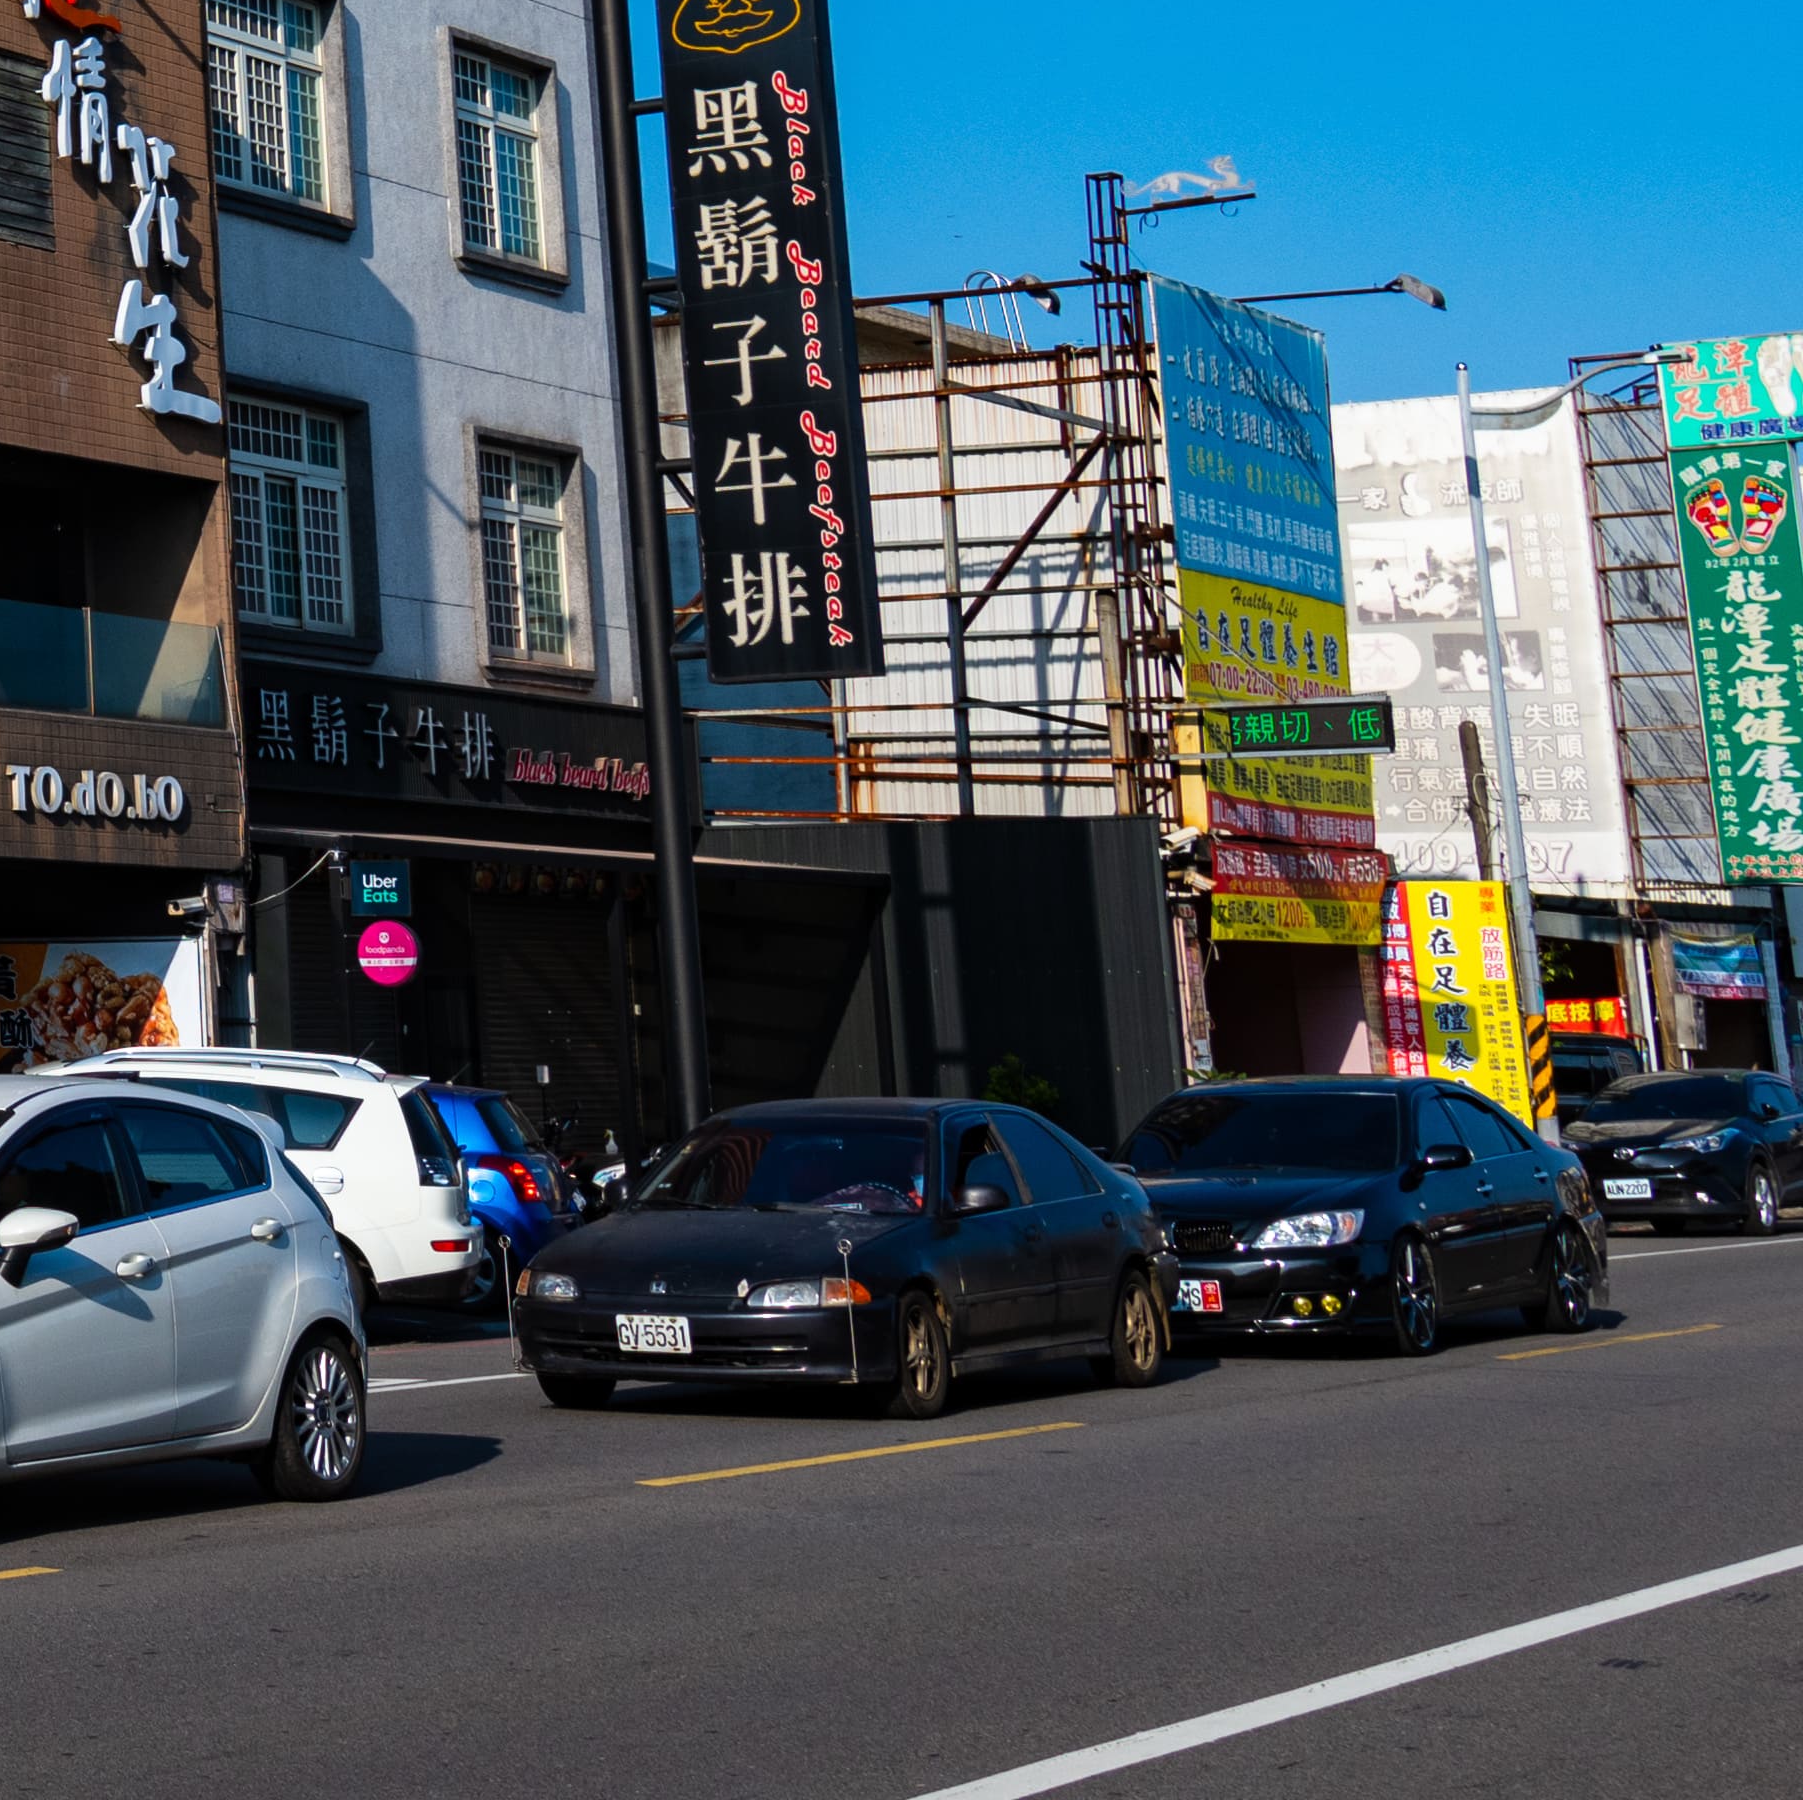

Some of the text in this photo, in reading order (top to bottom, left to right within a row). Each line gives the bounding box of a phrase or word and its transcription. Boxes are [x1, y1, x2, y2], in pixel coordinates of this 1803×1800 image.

[683, 78, 813, 648] 黑鬍子牛排
[771, 66, 851, 652] Black Beard Beefsteak
[1195, 608, 1340, 679] 自在足體養生館
[1231, 586, 1299, 623] Healthy Life
[256, 687, 495, 782] 黑鬍子牛排
[362, 873, 398, 889] Uber
[362, 889, 399, 904] Eats
[1427, 890, 1478, 1089] 自在足體養
